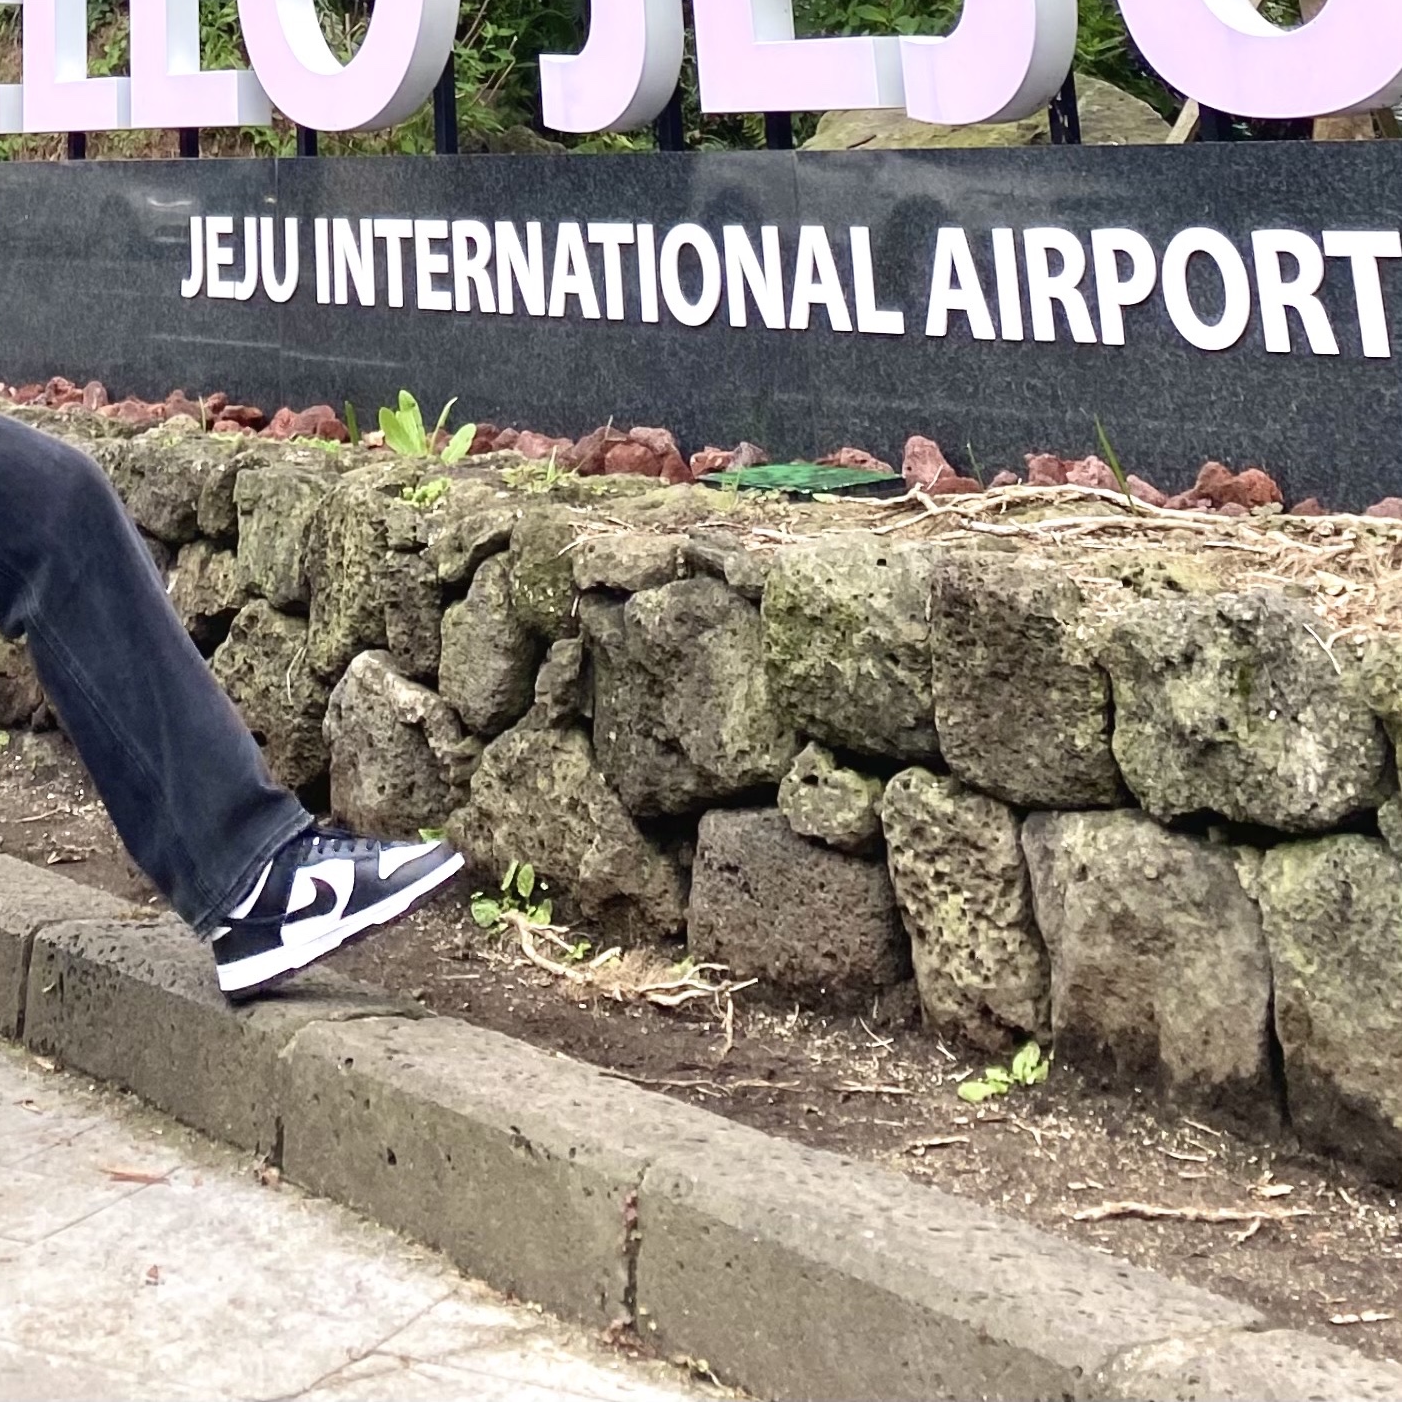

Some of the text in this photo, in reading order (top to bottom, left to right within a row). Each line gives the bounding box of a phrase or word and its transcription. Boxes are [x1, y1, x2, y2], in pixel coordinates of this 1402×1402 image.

[181, 216, 1402, 359] JEJU INTERNATIONAL AIRPORT
